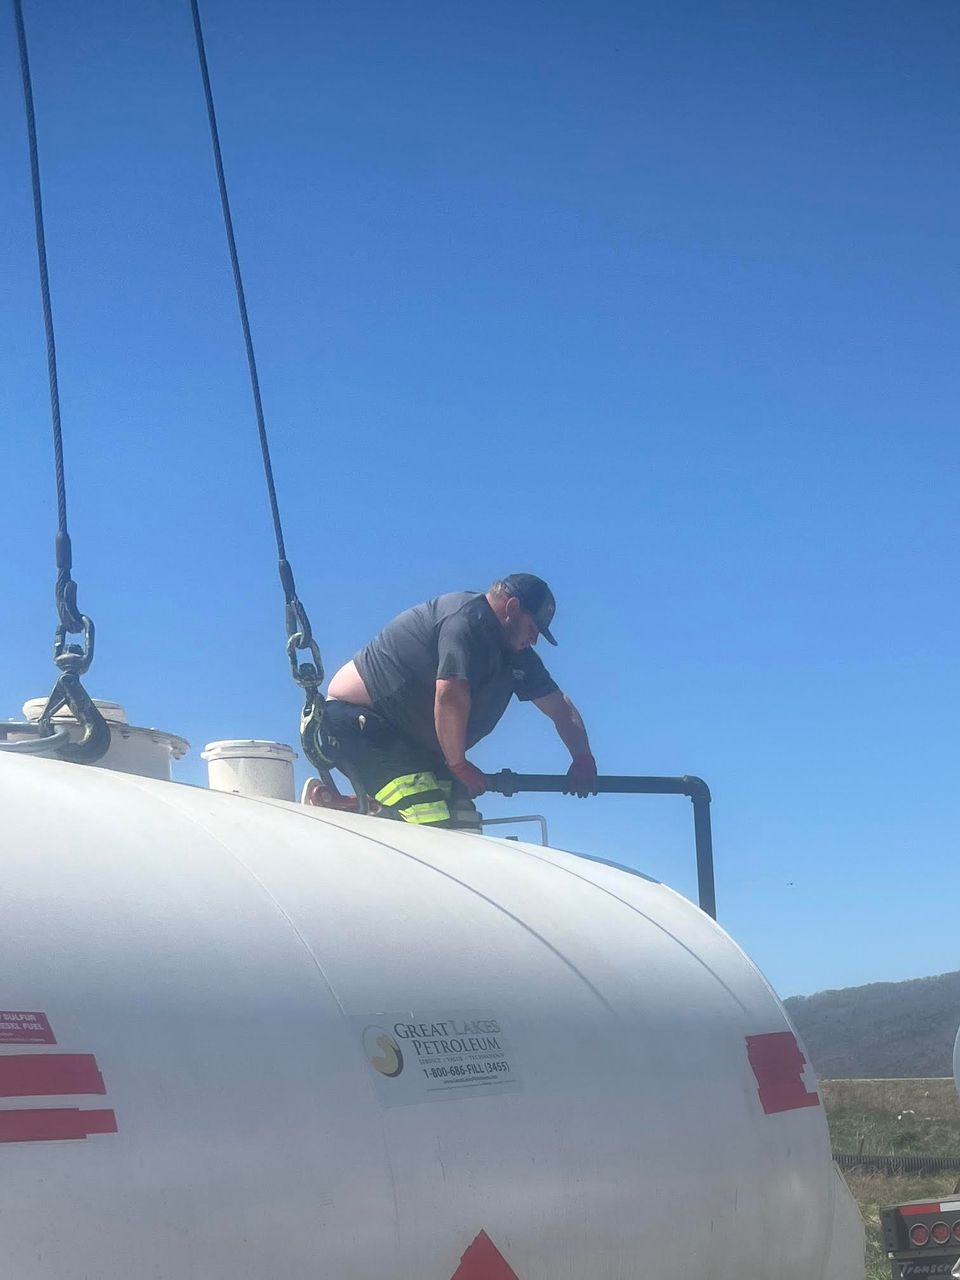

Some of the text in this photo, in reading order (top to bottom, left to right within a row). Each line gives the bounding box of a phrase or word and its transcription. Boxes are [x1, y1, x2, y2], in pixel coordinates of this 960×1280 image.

[22, 1022, 45, 1030] FUEL
[393, 1019, 501, 1039] GREAT LAKES
[413, 1036, 501, 1056] PETROLEUM
[423, 1064, 485, 1079] 1-800-686-FILL
[485, 1061, 510, 1074] (3455)
